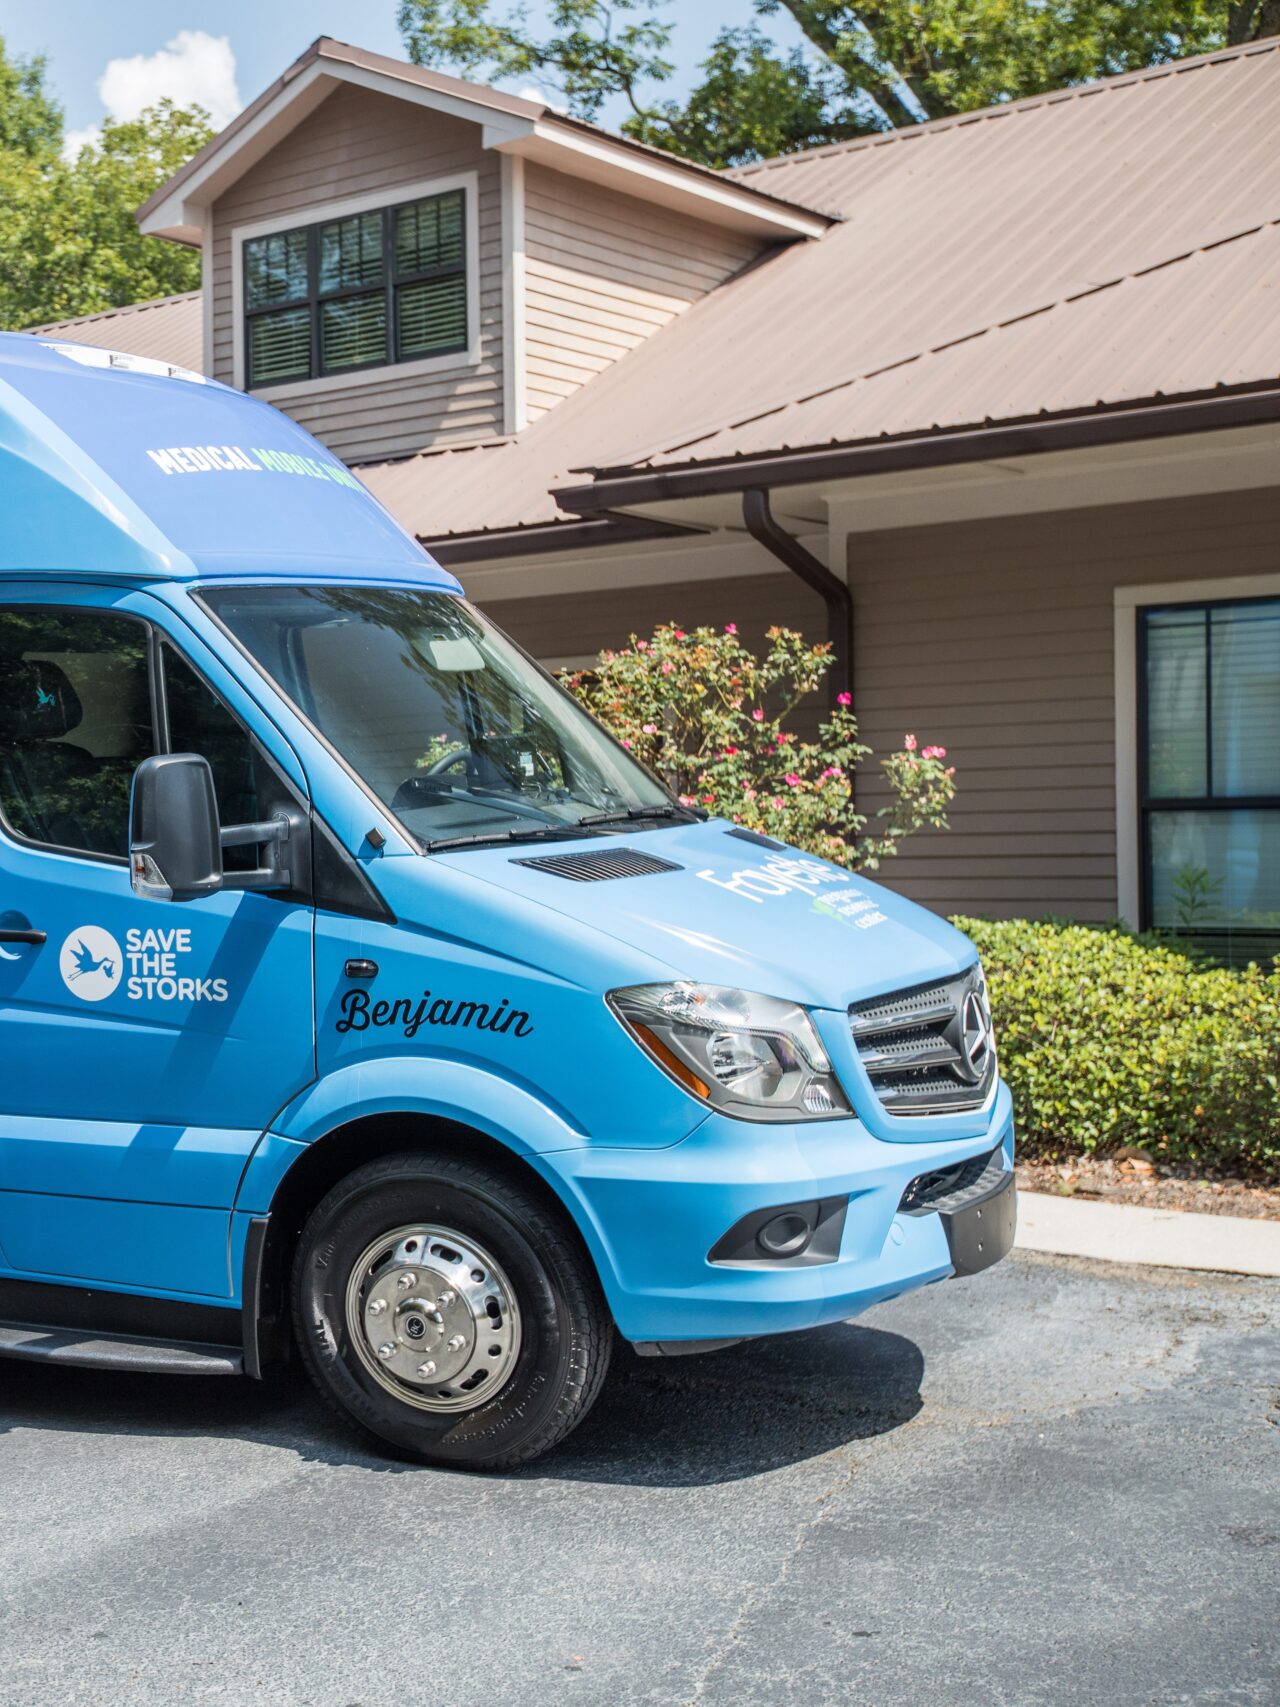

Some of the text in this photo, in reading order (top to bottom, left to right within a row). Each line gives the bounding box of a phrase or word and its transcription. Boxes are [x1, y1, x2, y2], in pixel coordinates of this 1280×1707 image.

[146, 445, 263, 475] MEDICAL
[250, 447, 331, 481] MOBILE
[696, 854, 850, 904] Fayette
[125, 928, 192, 952] SAVE
[125, 952, 177, 976] THE
[127, 976, 229, 1002] STORKS
[335, 988, 534, 1038] Benjamin
